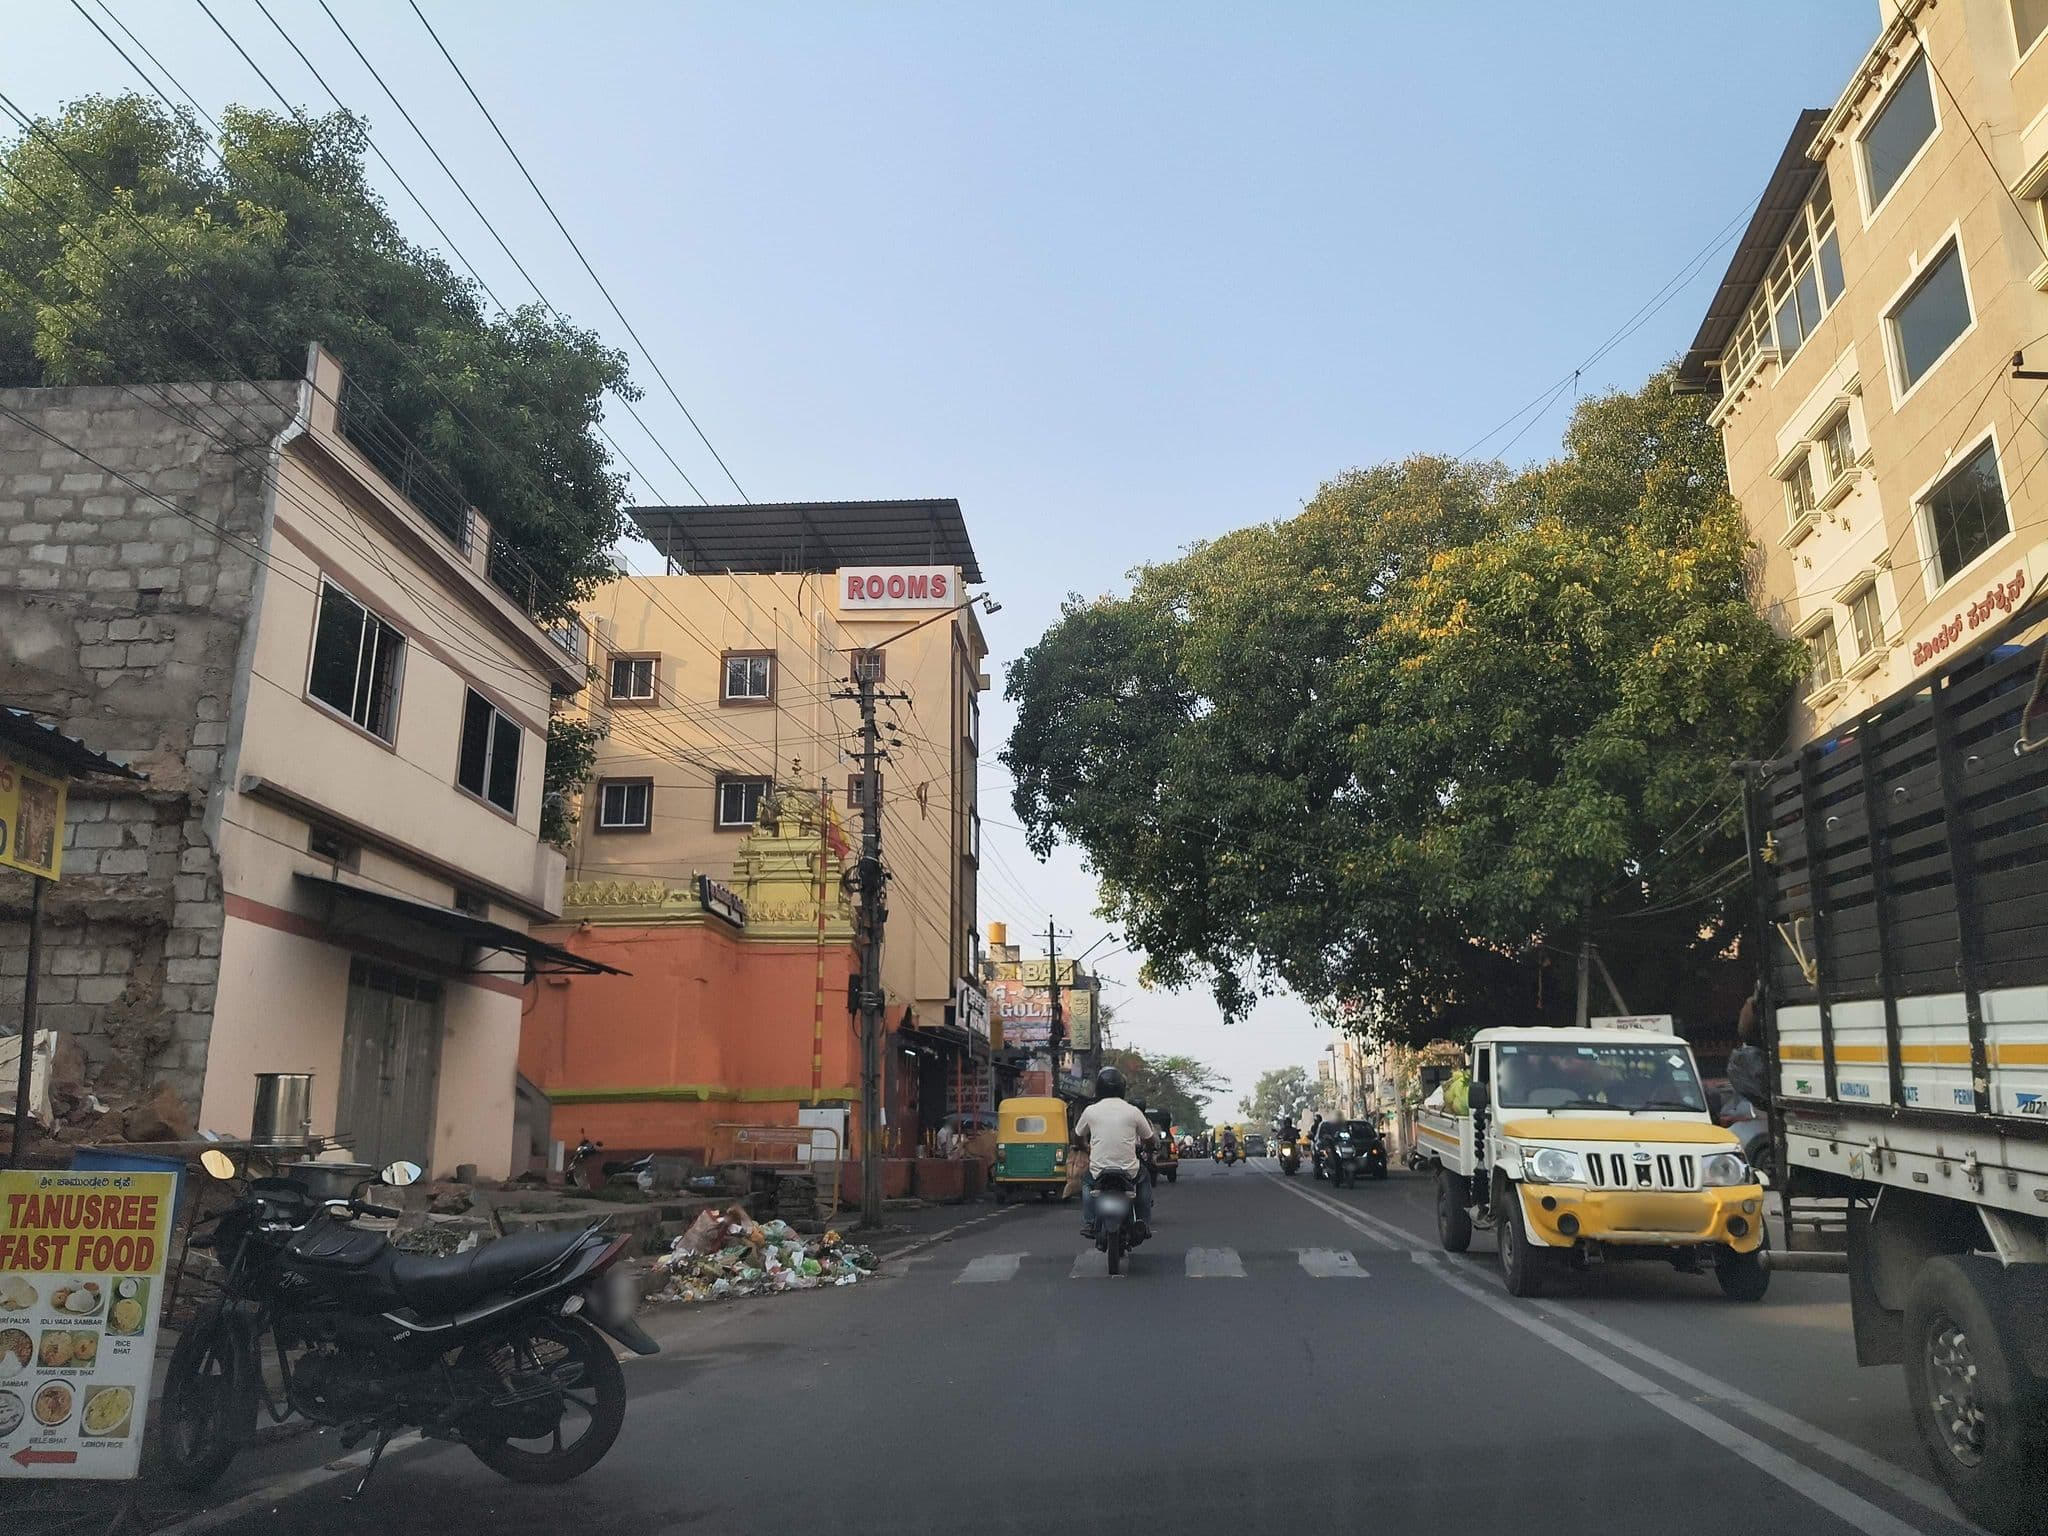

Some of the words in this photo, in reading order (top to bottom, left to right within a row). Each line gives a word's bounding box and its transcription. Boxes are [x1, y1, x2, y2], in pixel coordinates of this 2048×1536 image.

[847, 574, 947, 600] ROOMS
[1024, 962, 1071, 981] BAR
[1903, 1087, 1919, 1102] TATE
[1953, 1088, 1974, 1105] PERM
[8, 1193, 159, 1230] TANUSREE
[0, 1235, 71, 1271] FAST
[74, 1235, 155, 1272] FOOD
